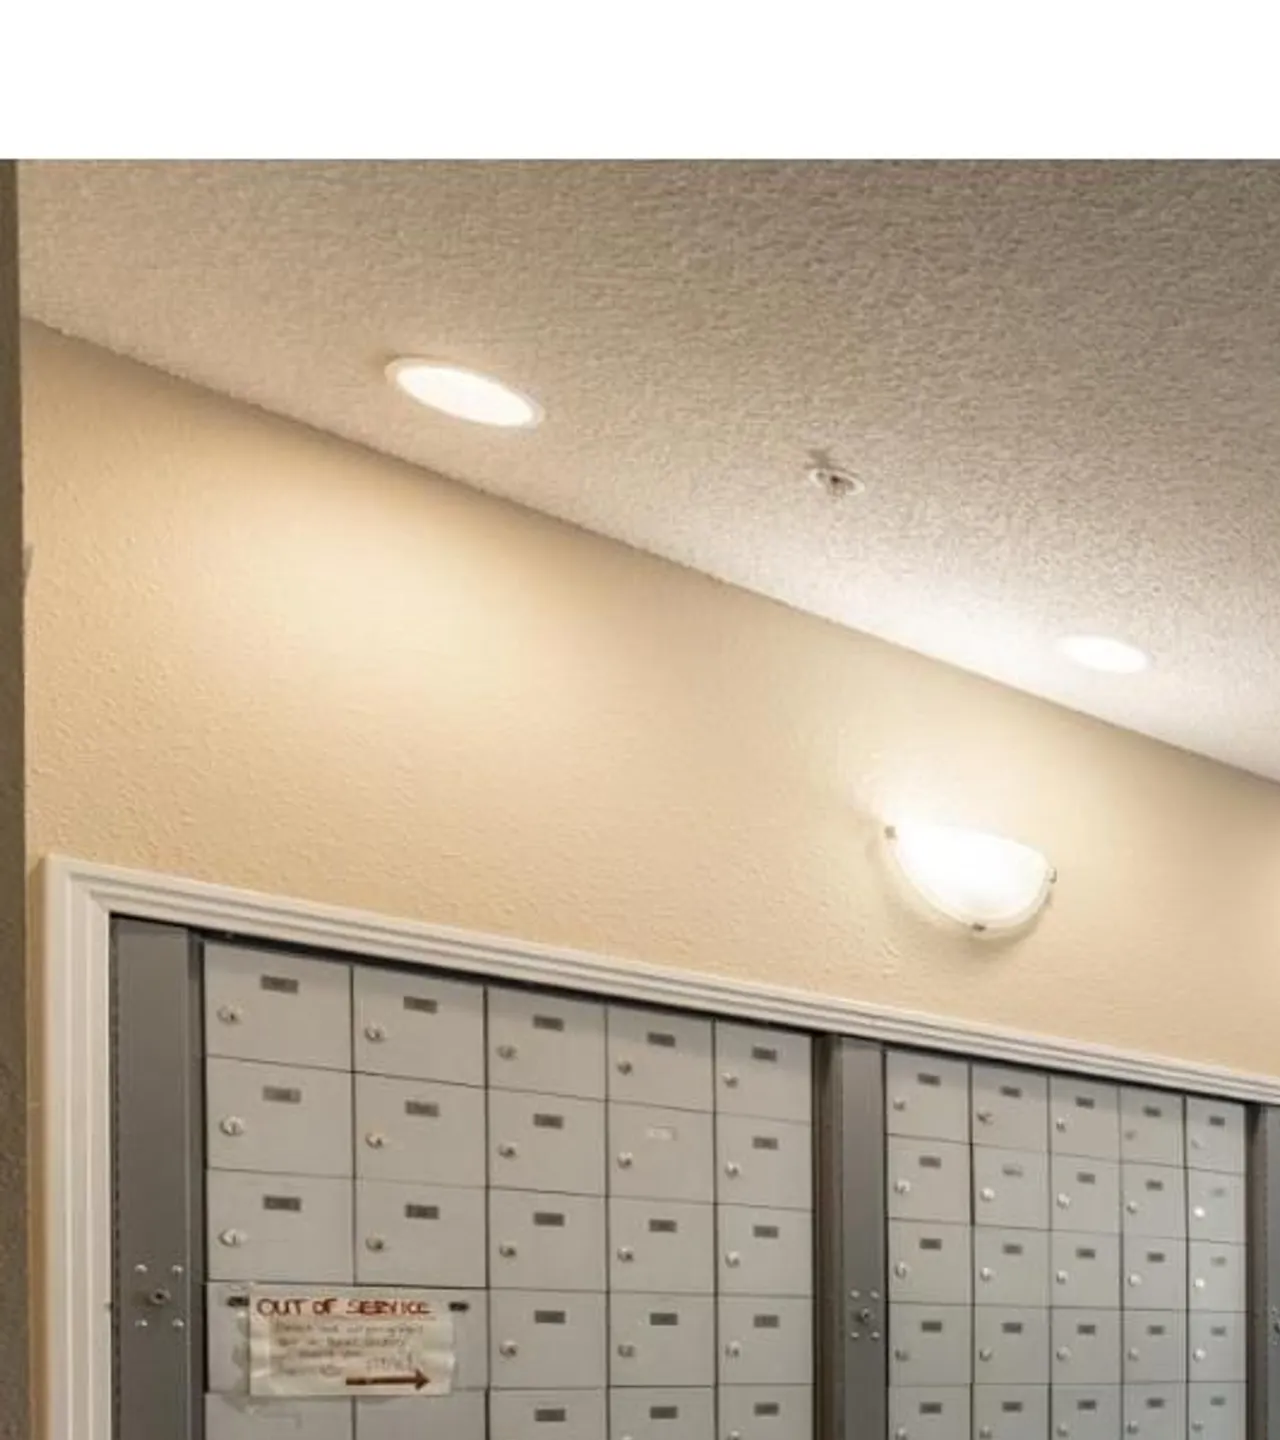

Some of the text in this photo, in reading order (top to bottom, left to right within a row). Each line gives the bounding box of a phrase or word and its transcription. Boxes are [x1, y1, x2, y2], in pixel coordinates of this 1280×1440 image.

[256, 1298, 434, 1317] OUT OF SERVICE
